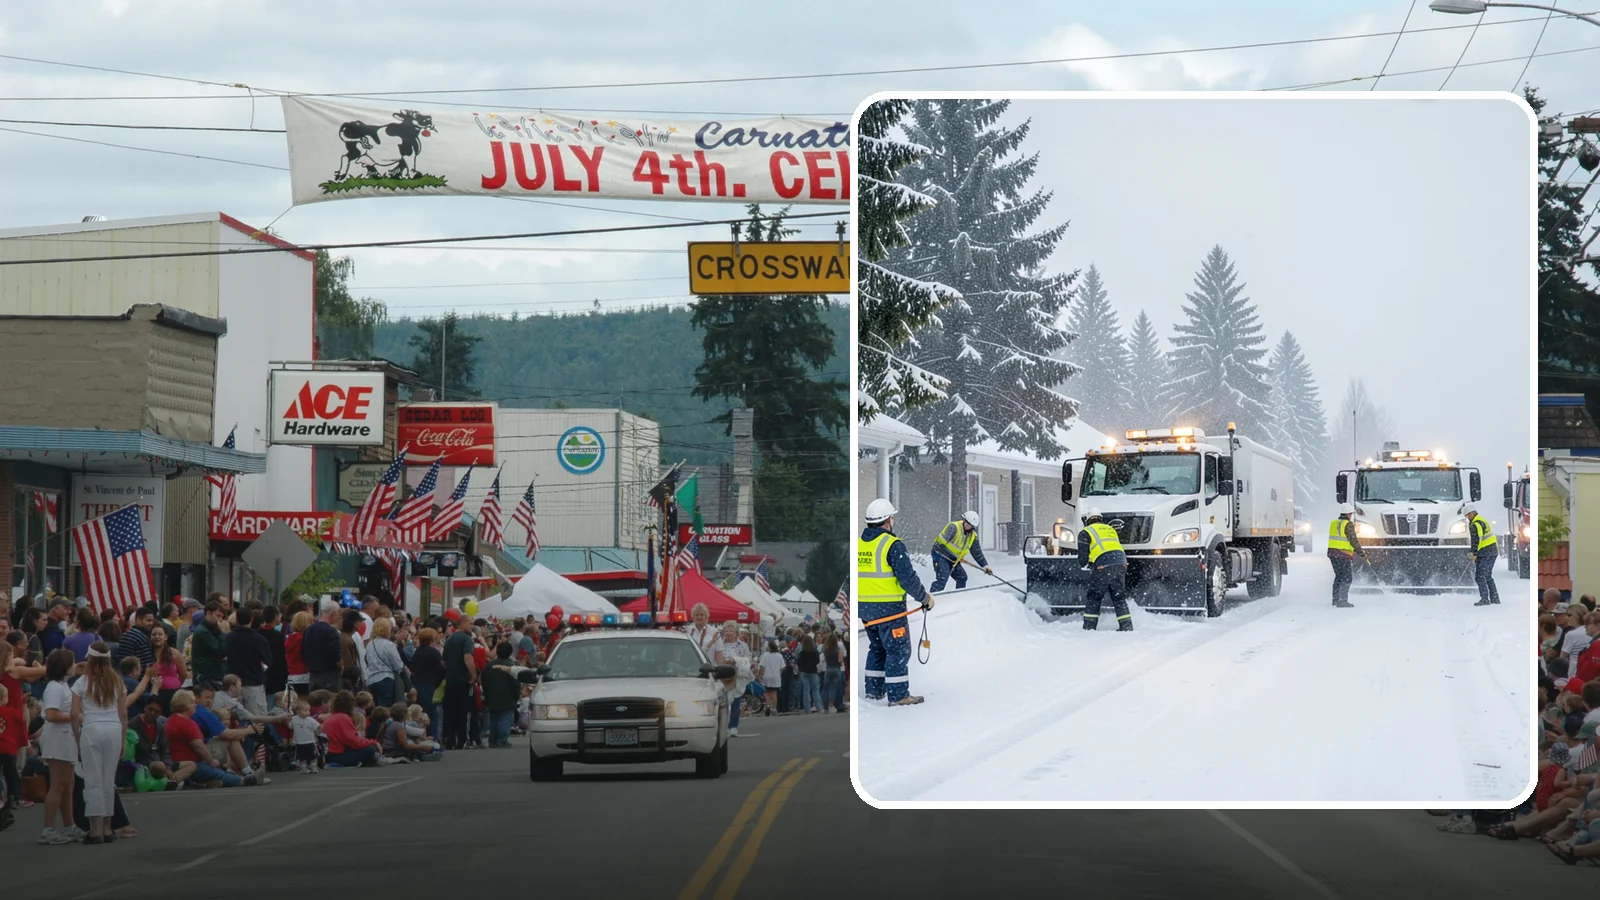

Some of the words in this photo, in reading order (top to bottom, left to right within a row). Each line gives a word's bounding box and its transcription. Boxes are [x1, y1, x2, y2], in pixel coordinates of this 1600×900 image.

[481, 141, 604, 193] JULY
[632, 150, 746, 198] 4th.
[697, 254, 850, 280] CROSSWA
[283, 380, 373, 420] ACE
[405, 409, 453, 422] CEDAR
[283, 421, 371, 436] Hardware
[416, 428, 477, 447] Coca-Cola
[353, 467, 386, 480] Simpl
[95, 485, 124, 495] Vincent
[126, 486, 136, 495] de
[137, 486, 155, 496] Paul
[81, 503, 154, 522] THT
[212, 516, 330, 535] HARDARE
[688, 526, 741, 535] CRNATION
[699, 535, 730, 543] GLASS
